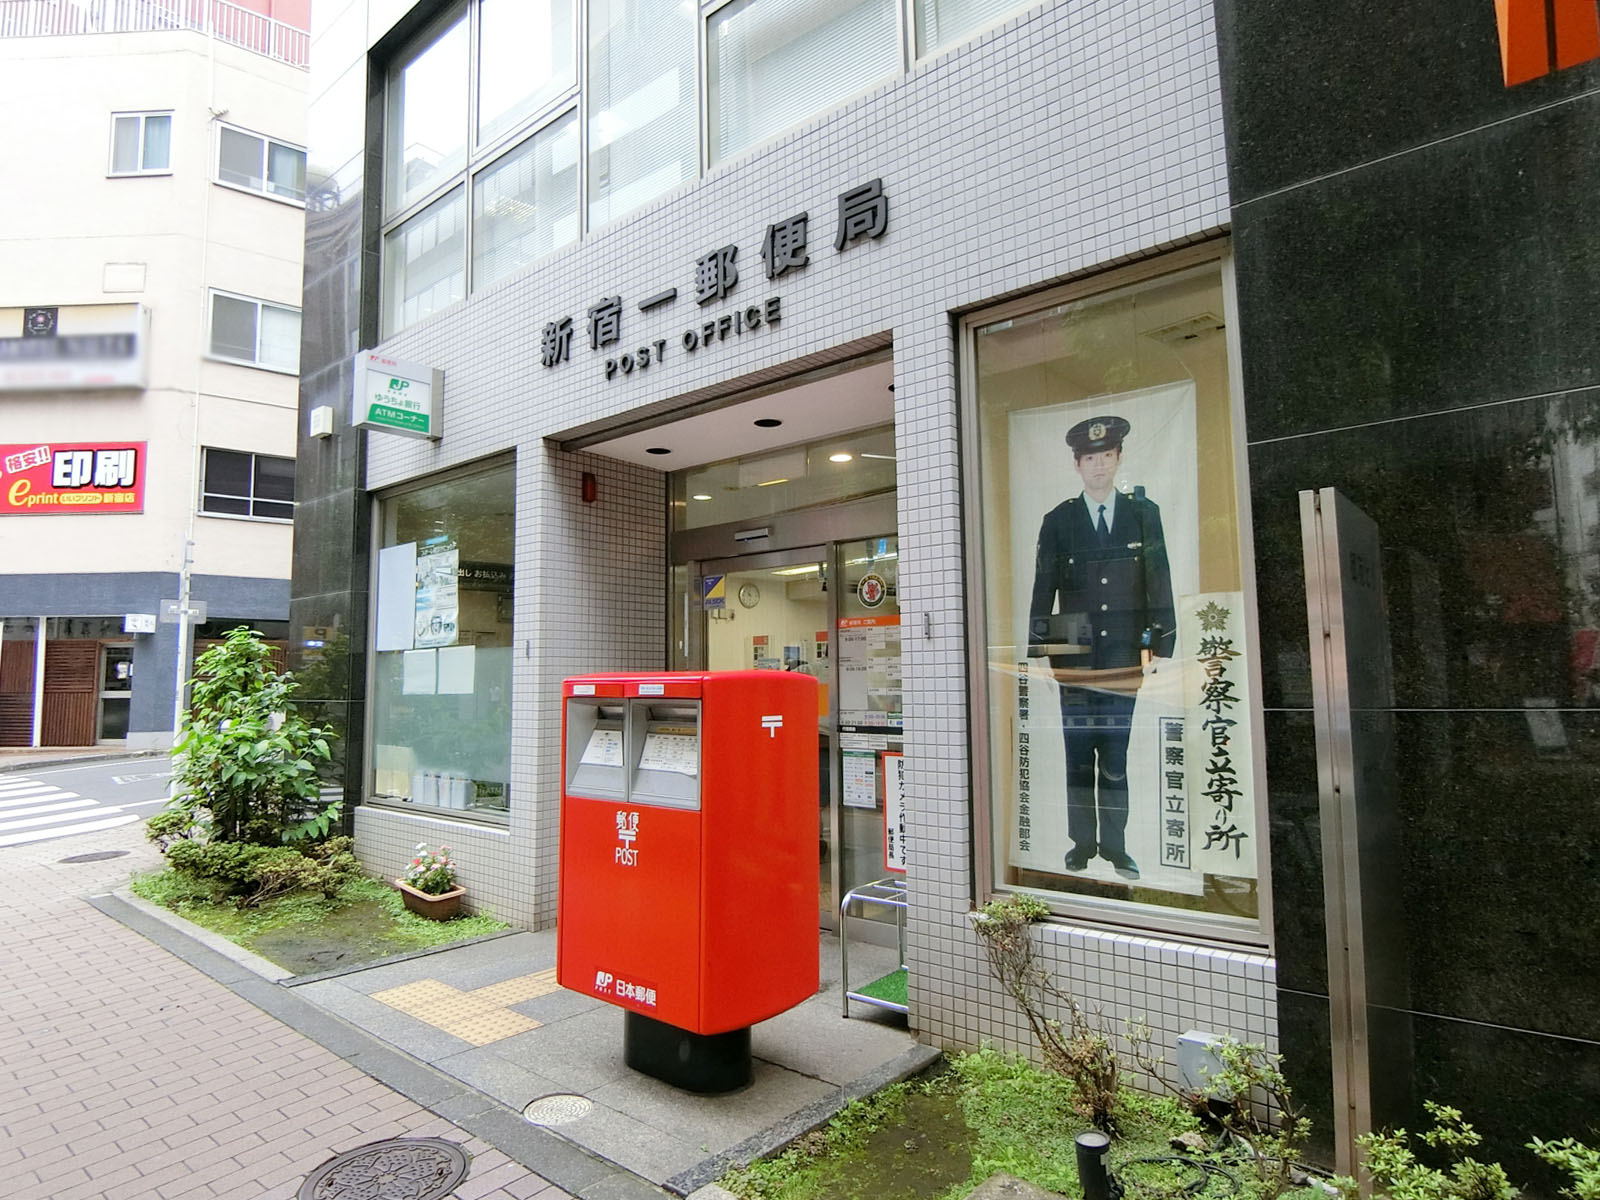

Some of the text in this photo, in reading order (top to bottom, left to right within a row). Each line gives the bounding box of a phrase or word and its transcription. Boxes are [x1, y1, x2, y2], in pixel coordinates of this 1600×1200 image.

[541, 178, 889, 368] 新宿一郵便局
[605, 296, 782, 380] POST OFFICE
[375, 393, 421, 411] ゆうちょ銀行
[375, 408, 424, 424] ATMコーナー
[52, 449, 137, 488] 印刷
[8, 479, 59, 507] eprint
[1195, 634, 1249, 861] 警察官立寄り所
[1164, 722, 1185, 864] 警察官立寄所
[615, 811, 640, 832] 郵便
[615, 848, 639, 867] POST
[616, 979, 657, 1007] 日本郵便
